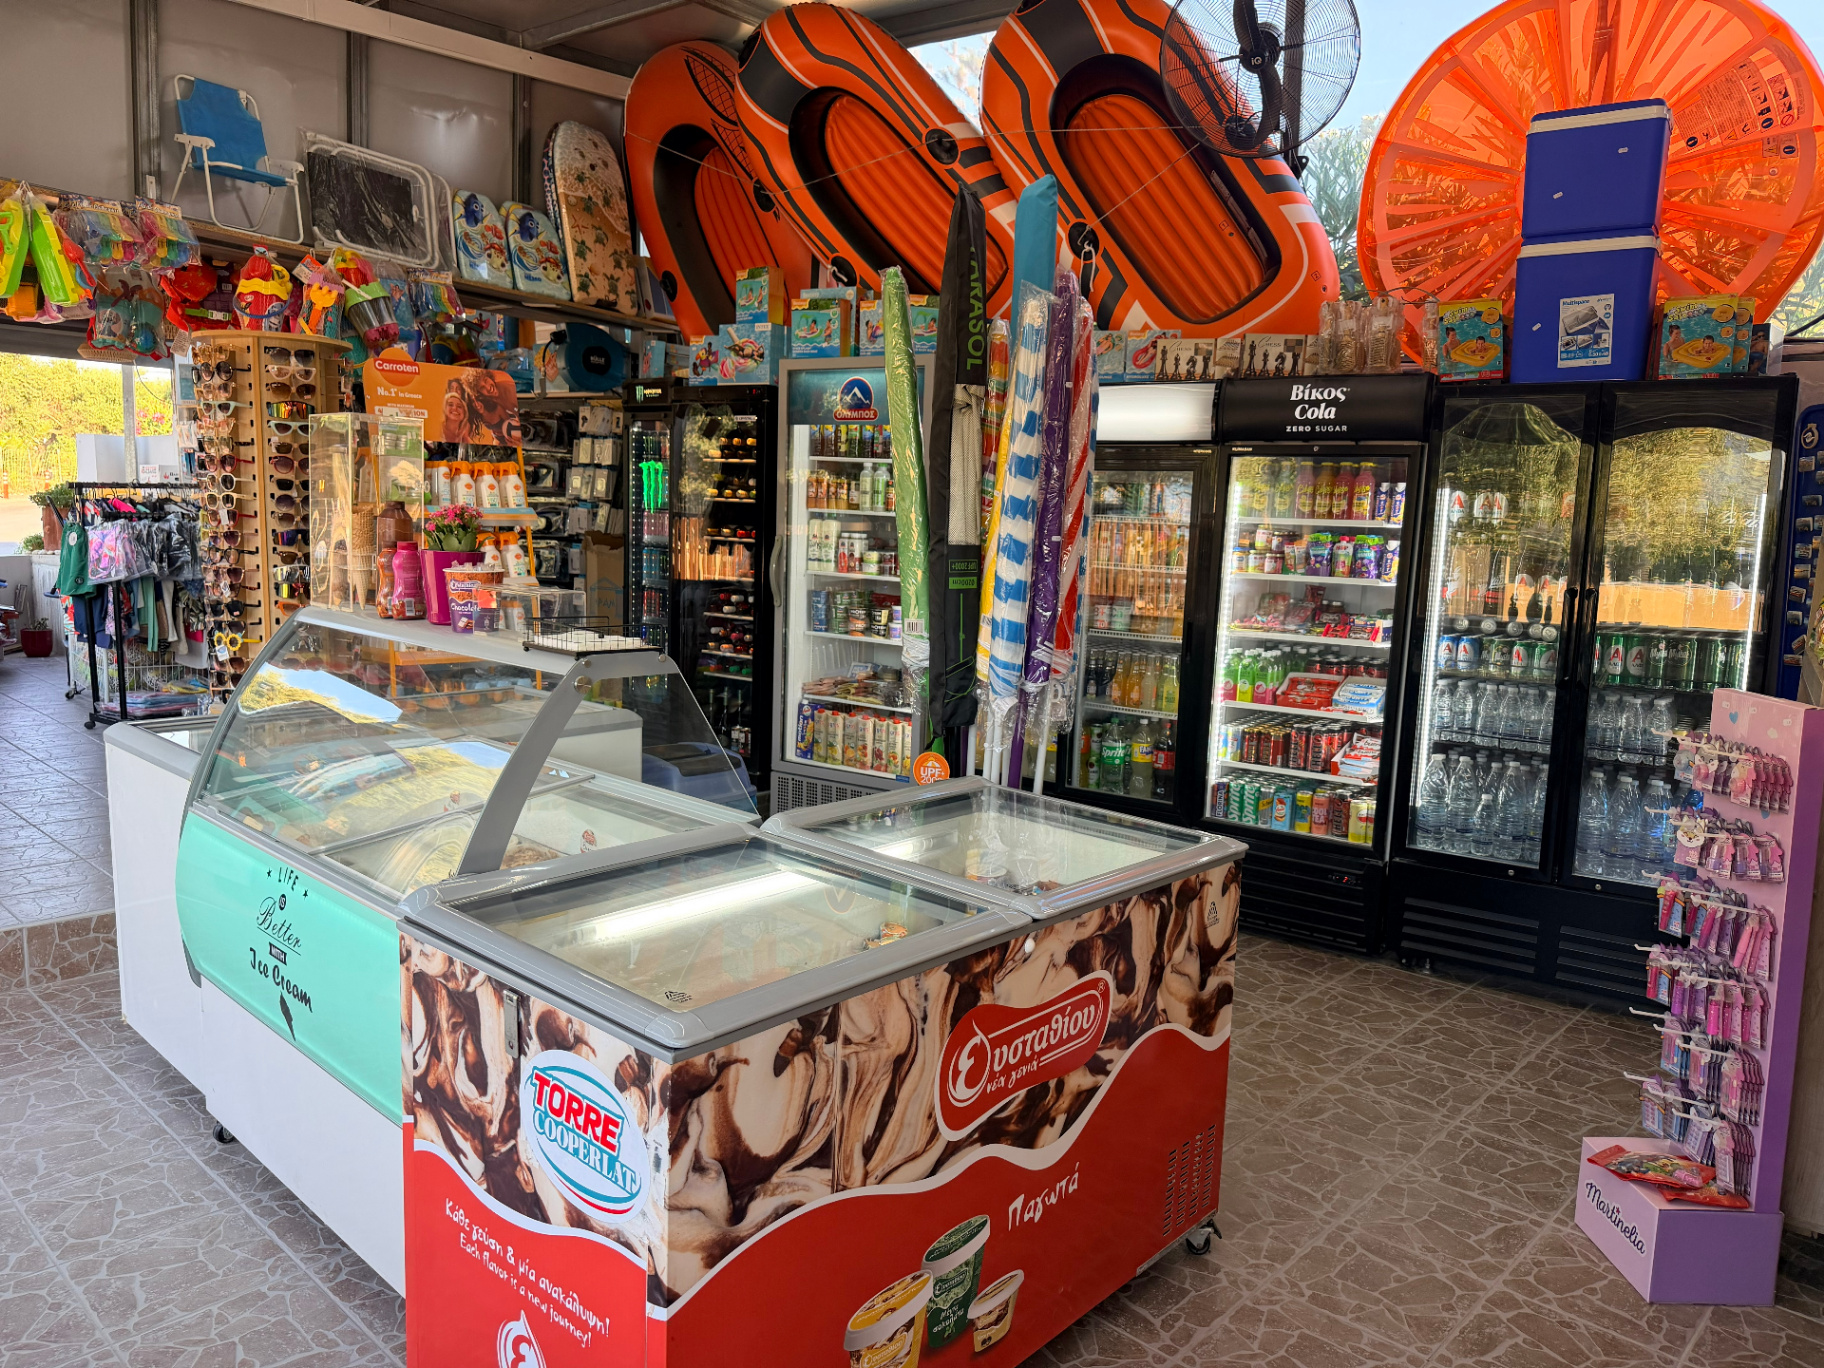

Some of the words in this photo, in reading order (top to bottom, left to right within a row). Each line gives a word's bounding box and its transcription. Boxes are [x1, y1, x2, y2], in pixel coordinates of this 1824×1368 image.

[967, 259, 985, 371] ARASOL
[374, 361, 419, 374] Carroten
[836, 410, 875, 419] ΟΛΥΜΠΟΣ
[1294, 402, 1337, 420] Cola
[450, 603, 481, 612] Chocolate
[1101, 746, 1125, 758] Sprite
[1228, 781, 1241, 821] Sprite
[1243, 783, 1256, 824] Sprite
[278, 866, 299, 892] LIFE
[256, 897, 302, 949] Better
[270, 944, 285, 963] WITH
[272, 964, 314, 1014] Cream
[534, 1072, 621, 1154] TORRE
[533, 1110, 637, 1195] COOPERLAT
[1008, 1161, 1080, 1232] Παγωτά
[1585, 1181, 1646, 1255] Martinelia
[445, 1197, 470, 1231] Κάθε
[472, 1224, 504, 1257] γεύση
[506, 1246, 515, 1266] &
[518, 1258, 536, 1283] μία
[460, 1232, 481, 1260] Each
[482, 1251, 508, 1280] flavor
[510, 1273, 518, 1290] is
[519, 1285, 526, 1297] a
[527, 1289, 548, 1314] new
[549, 1303, 592, 1348] journey!
